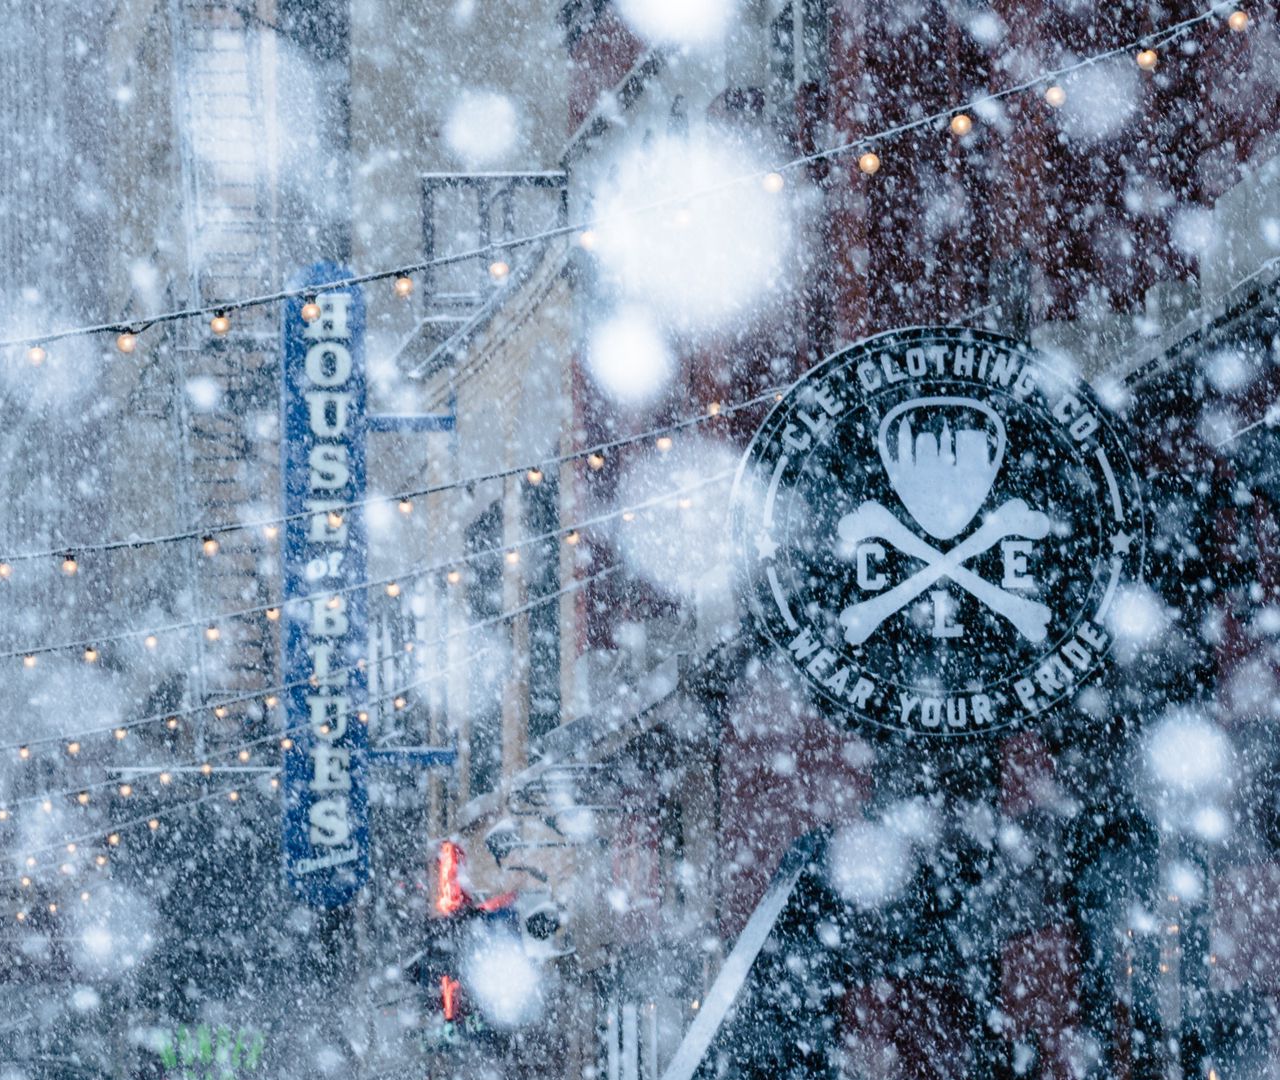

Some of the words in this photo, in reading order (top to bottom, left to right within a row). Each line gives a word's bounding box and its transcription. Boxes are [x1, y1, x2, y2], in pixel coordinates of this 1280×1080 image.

[304, 293, 352, 543] HOUSE
[781, 380, 844, 450] CLE
[857, 347, 1038, 396] CLOTHING
[1052, 397, 1098, 451] CO.
[305, 551, 344, 580] of
[306, 597, 351, 847] BLUES
[789, 627, 875, 709] WEAR
[899, 690, 998, 728] YOUR
[1013, 619, 1108, 711] PRIDE
